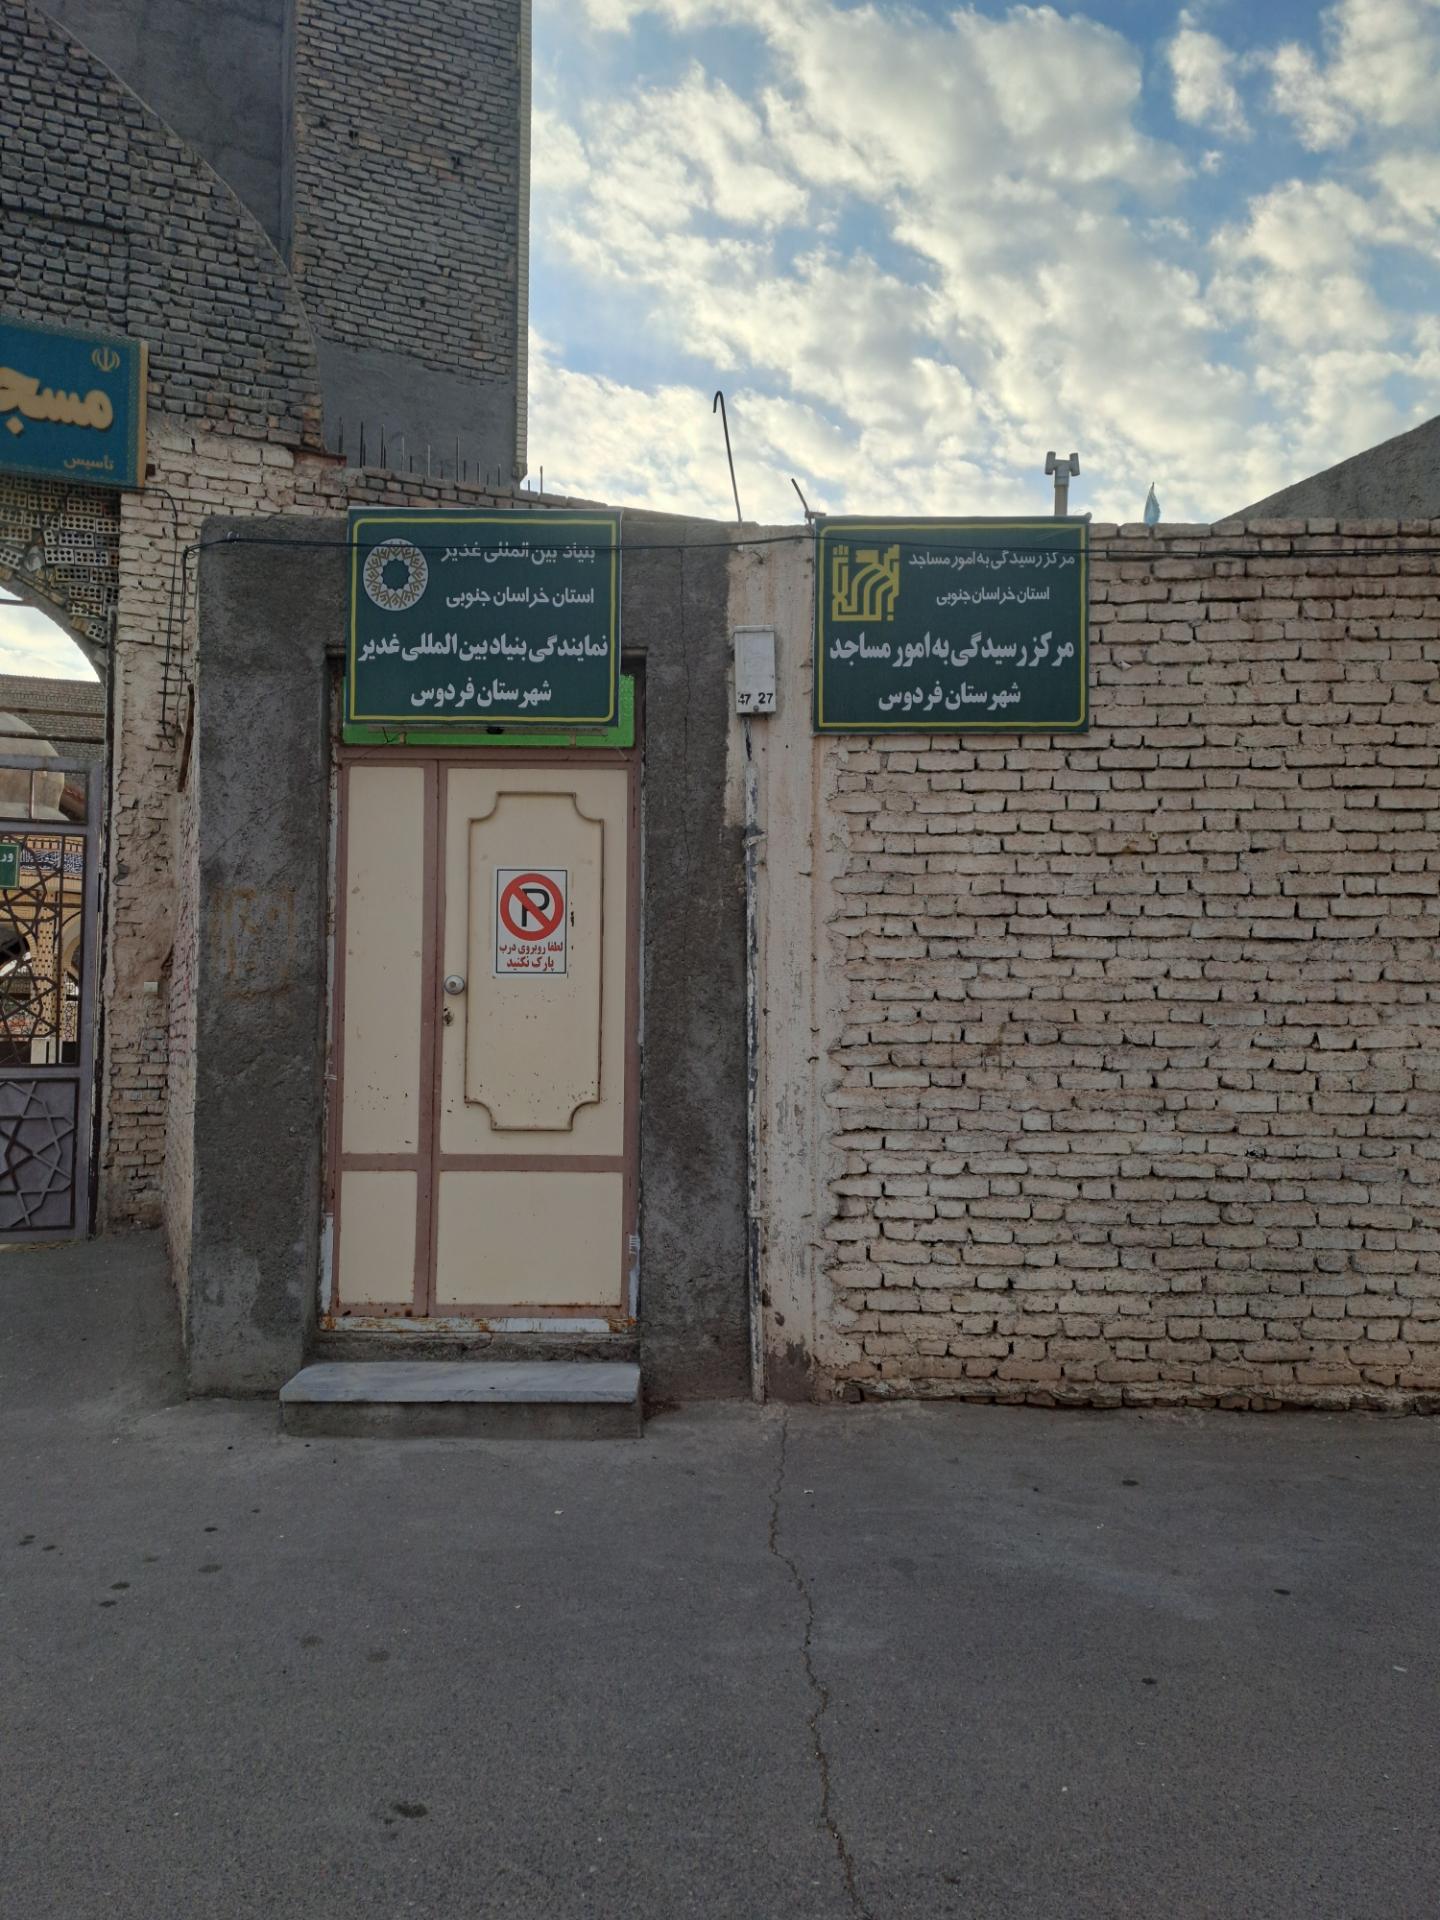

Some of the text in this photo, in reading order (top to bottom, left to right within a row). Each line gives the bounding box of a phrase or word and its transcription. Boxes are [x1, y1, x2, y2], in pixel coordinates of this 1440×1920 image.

[0, 366, 114, 436] مسج
[440, 541, 596, 566] بنیاد بین المللی غدیر
[908, 550, 1076, 571] مرکز رسیدگی به امور مساجد
[446, 587, 595, 609] استان خراسان جنوبی
[936, 586, 1050, 607] استان خراسان جنوبی
[357, 632, 609, 663] نمایندگی بنیاد بین المللی غدیر
[829, 631, 1075, 668] مرکز رسیدگی به امور مساجد
[410, 677, 552, 709] شهرستان فردوس
[758, 691, 774, 705] 27
[878, 680, 1021, 711] شهرستان فردوس
[499, 941, 564, 955] لطفا روبروی درب
[506, 955, 555, 972] پارک نکنید
